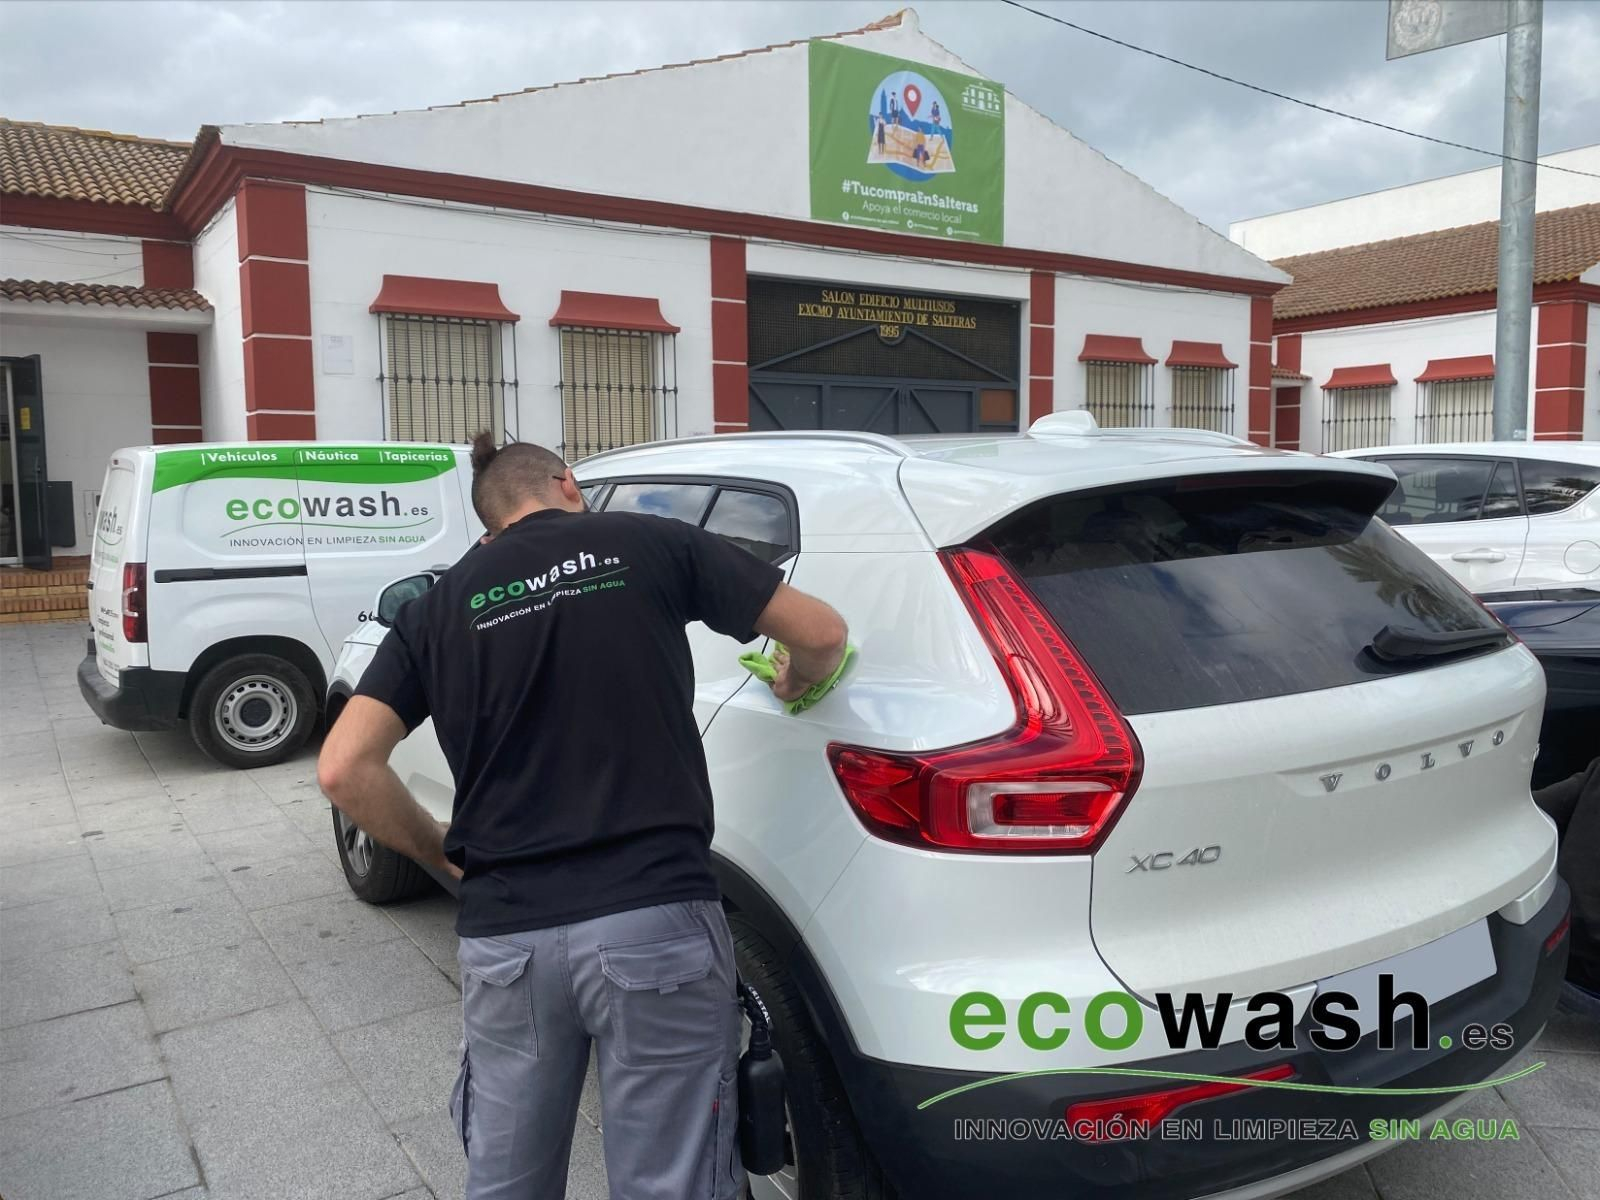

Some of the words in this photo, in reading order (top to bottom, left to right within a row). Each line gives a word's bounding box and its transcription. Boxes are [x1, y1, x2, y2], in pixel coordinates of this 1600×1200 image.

[842, 179, 979, 214] #TucompraEnSalteras
[862, 200, 891, 215] Apoya
[892, 206, 902, 215] el
[903, 207, 940, 222] comercio
[941, 212, 963, 225] local
[821, 289, 856, 305] SALON
[859, 294, 900, 309] EDIFICIO
[903, 298, 956, 314] MULTIUSOS
[799, 303, 833, 318] EXCMO
[836, 307, 914, 325] AYUNTAMIENTO
[916, 313, 929, 326] DE
[932, 316, 977, 330] SALTERAS
[879, 325, 900, 338] 1995
[206, 450, 278, 463] Vehículos
[304, 450, 359, 462] Náutica
[225, 490, 429, 521] ecowash.es
[229, 536, 303, 547] INNOVACIÓN
[307, 536, 323, 545] EN
[326, 535, 377, 545] LIMPIEZA
[378, 535, 395, 544] SIN
[398, 535, 426, 543] AGUA
[470, 551, 621, 610] ecowash.es
[476, 606, 532, 631] INNOVACIÓN
[533, 602, 546, 611] EN
[582, 584, 598, 593] SIN
[599, 579, 626, 590] AGUA
[1318, 730, 1505, 793] VOLVO
